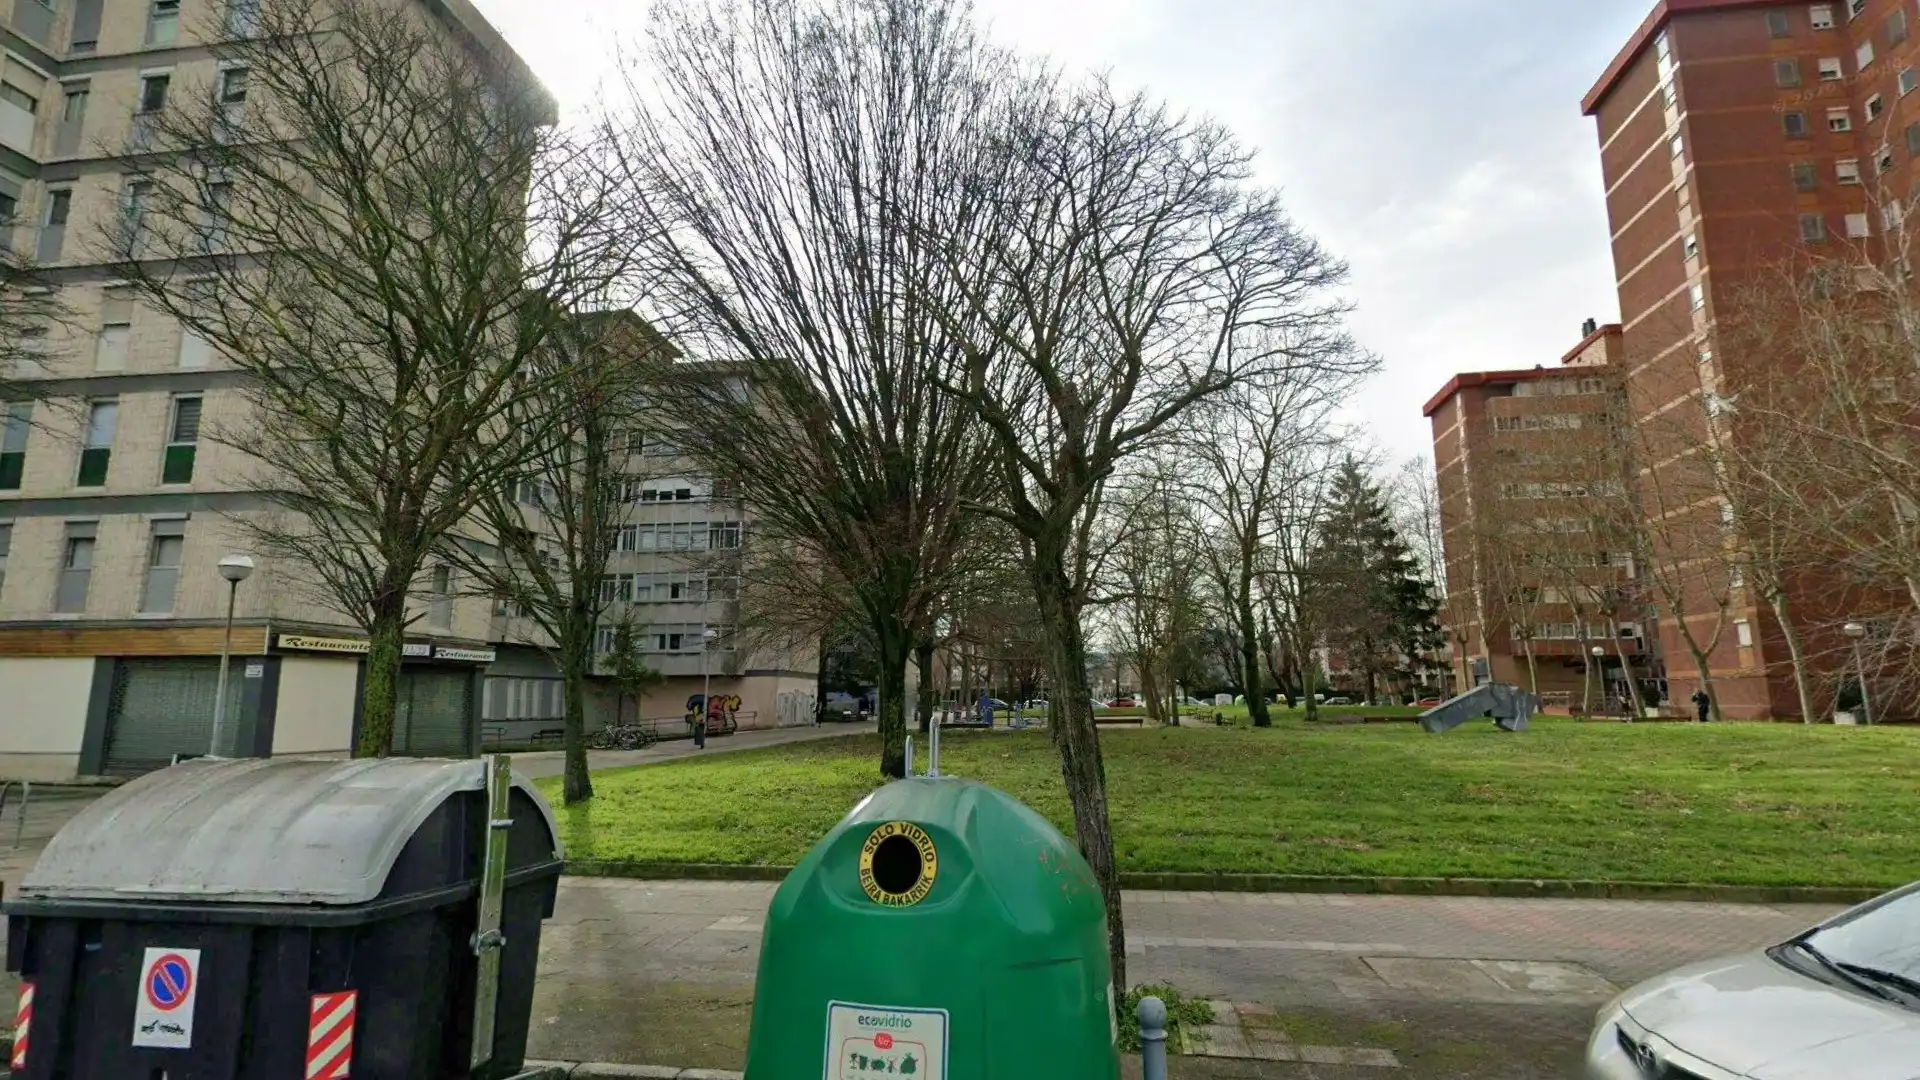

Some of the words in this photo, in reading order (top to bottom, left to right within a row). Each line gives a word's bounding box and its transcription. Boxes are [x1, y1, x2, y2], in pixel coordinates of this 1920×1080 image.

[436, 649, 492, 659] Restaurante
[864, 824, 894, 855] SOLO
[900, 823, 935, 863] VIDRIO
[860, 867, 881, 901] BEIRA
[882, 875, 933, 907] BAKARRIK
[858, 1013, 912, 1028] ecovidrio
